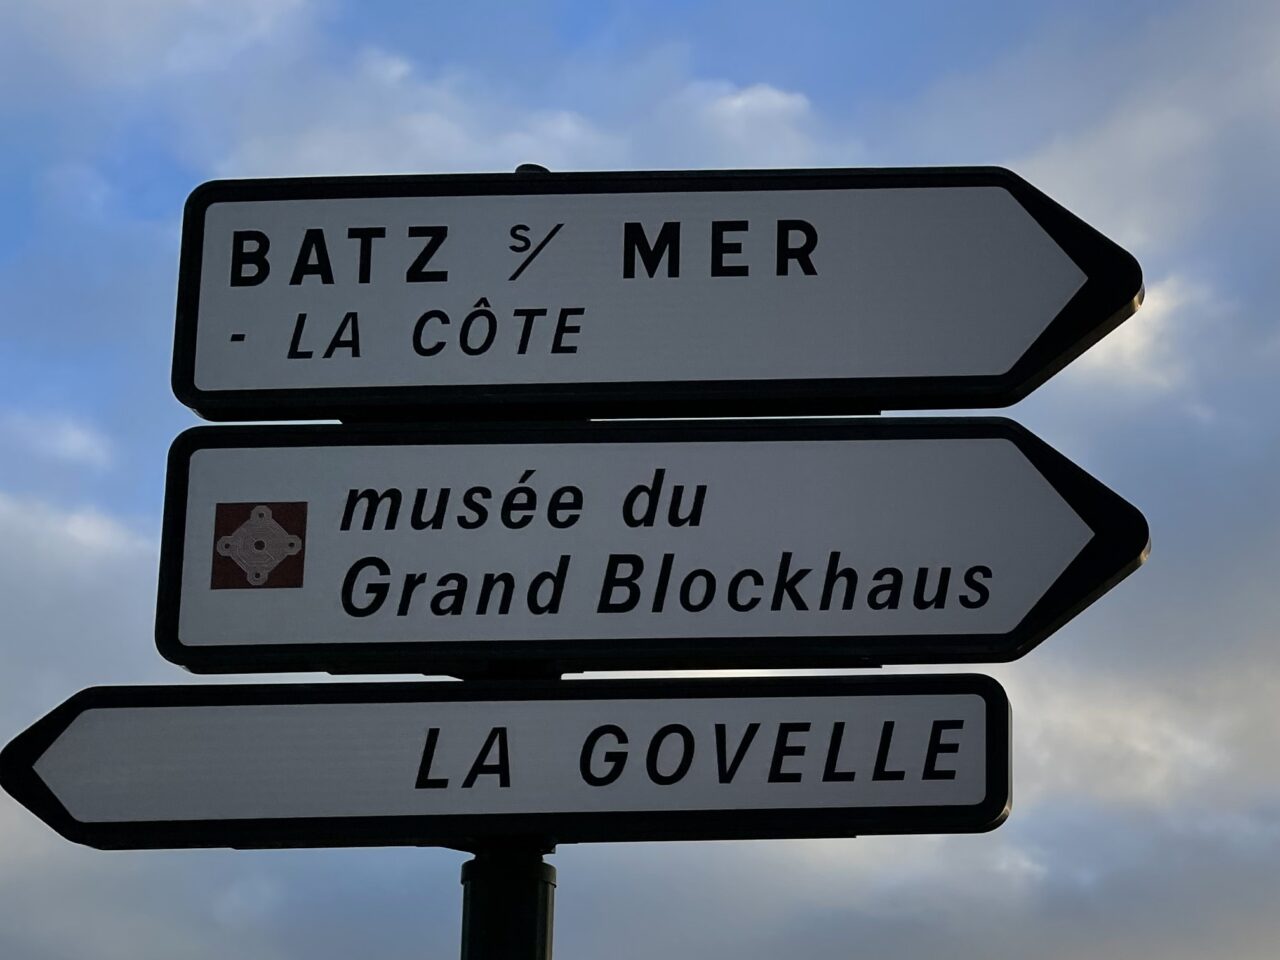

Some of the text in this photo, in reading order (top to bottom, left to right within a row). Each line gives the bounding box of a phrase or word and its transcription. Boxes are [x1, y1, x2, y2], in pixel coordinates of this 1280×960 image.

[229, 225, 450, 288] BATZ
[622, 218, 820, 280] MER
[286, 311, 363, 361] LA
[411, 296, 587, 358] CÔTE
[339, 467, 709, 532] musée du
[339, 550, 996, 619] Grand Blockhaus
[413, 718, 966, 790] LA GOVELLE
